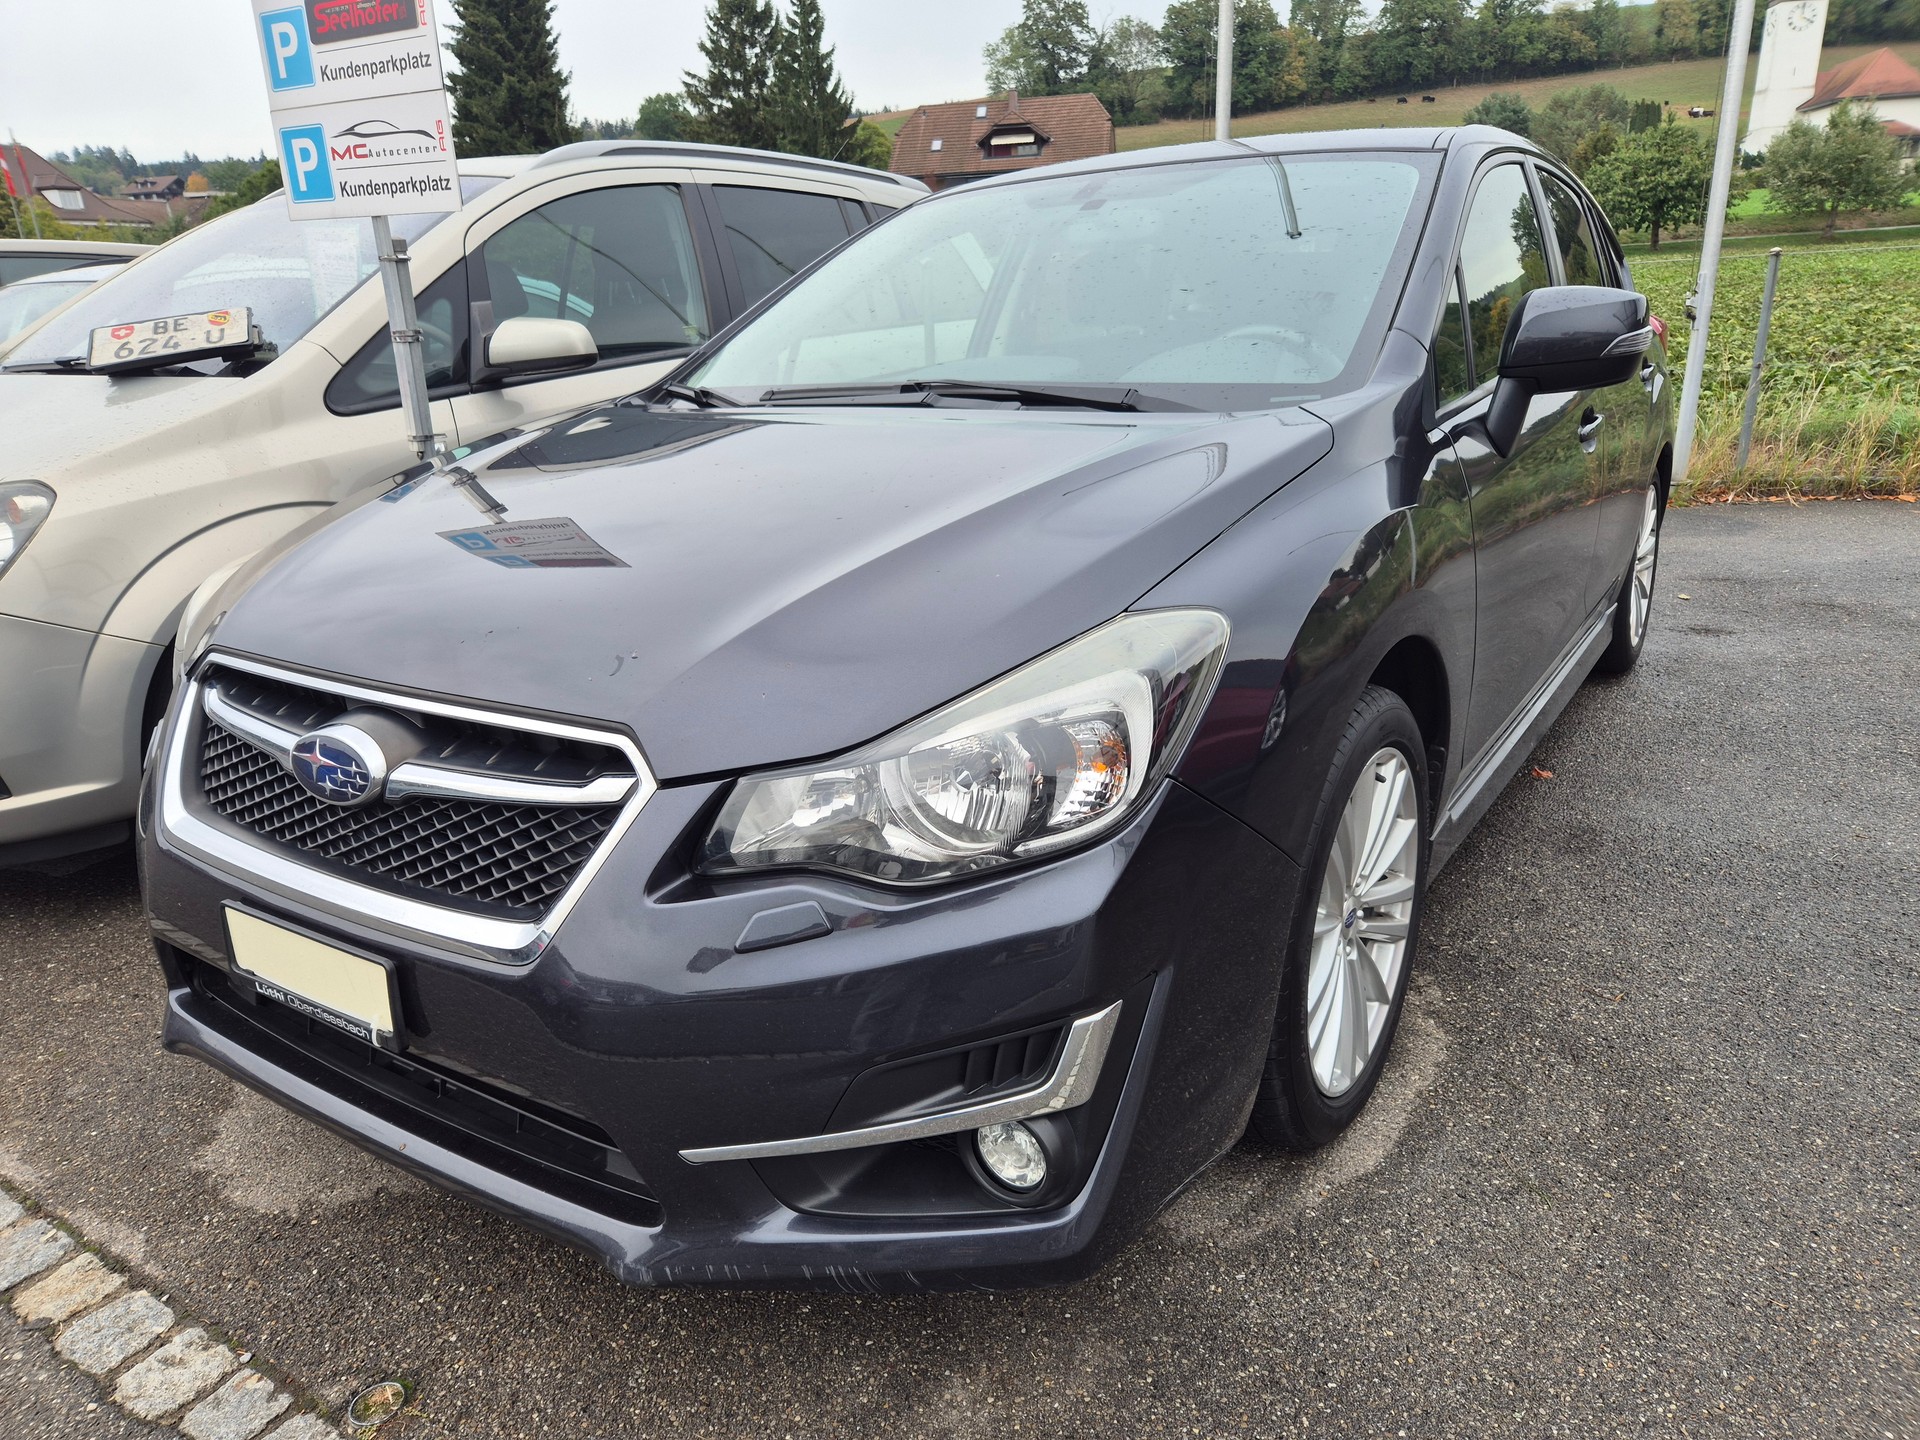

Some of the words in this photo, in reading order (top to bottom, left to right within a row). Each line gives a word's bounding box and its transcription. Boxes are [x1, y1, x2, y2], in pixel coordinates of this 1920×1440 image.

[313, 0, 400, 34] Seelhofer
[271, 21, 298, 79] P
[320, 52, 432, 82] Kundenparkplatz
[330, 143, 369, 161] MC
[368, 145, 438, 158] Autocenter
[435, 119, 447, 152] AG
[291, 138, 318, 191] P
[339, 175, 452, 199] Kundenparkplatz
[153, 317, 188, 335] BE
[255, 981, 285, 1002] Lüthi
[287, 995, 370, 1040] Oberdiessbach
